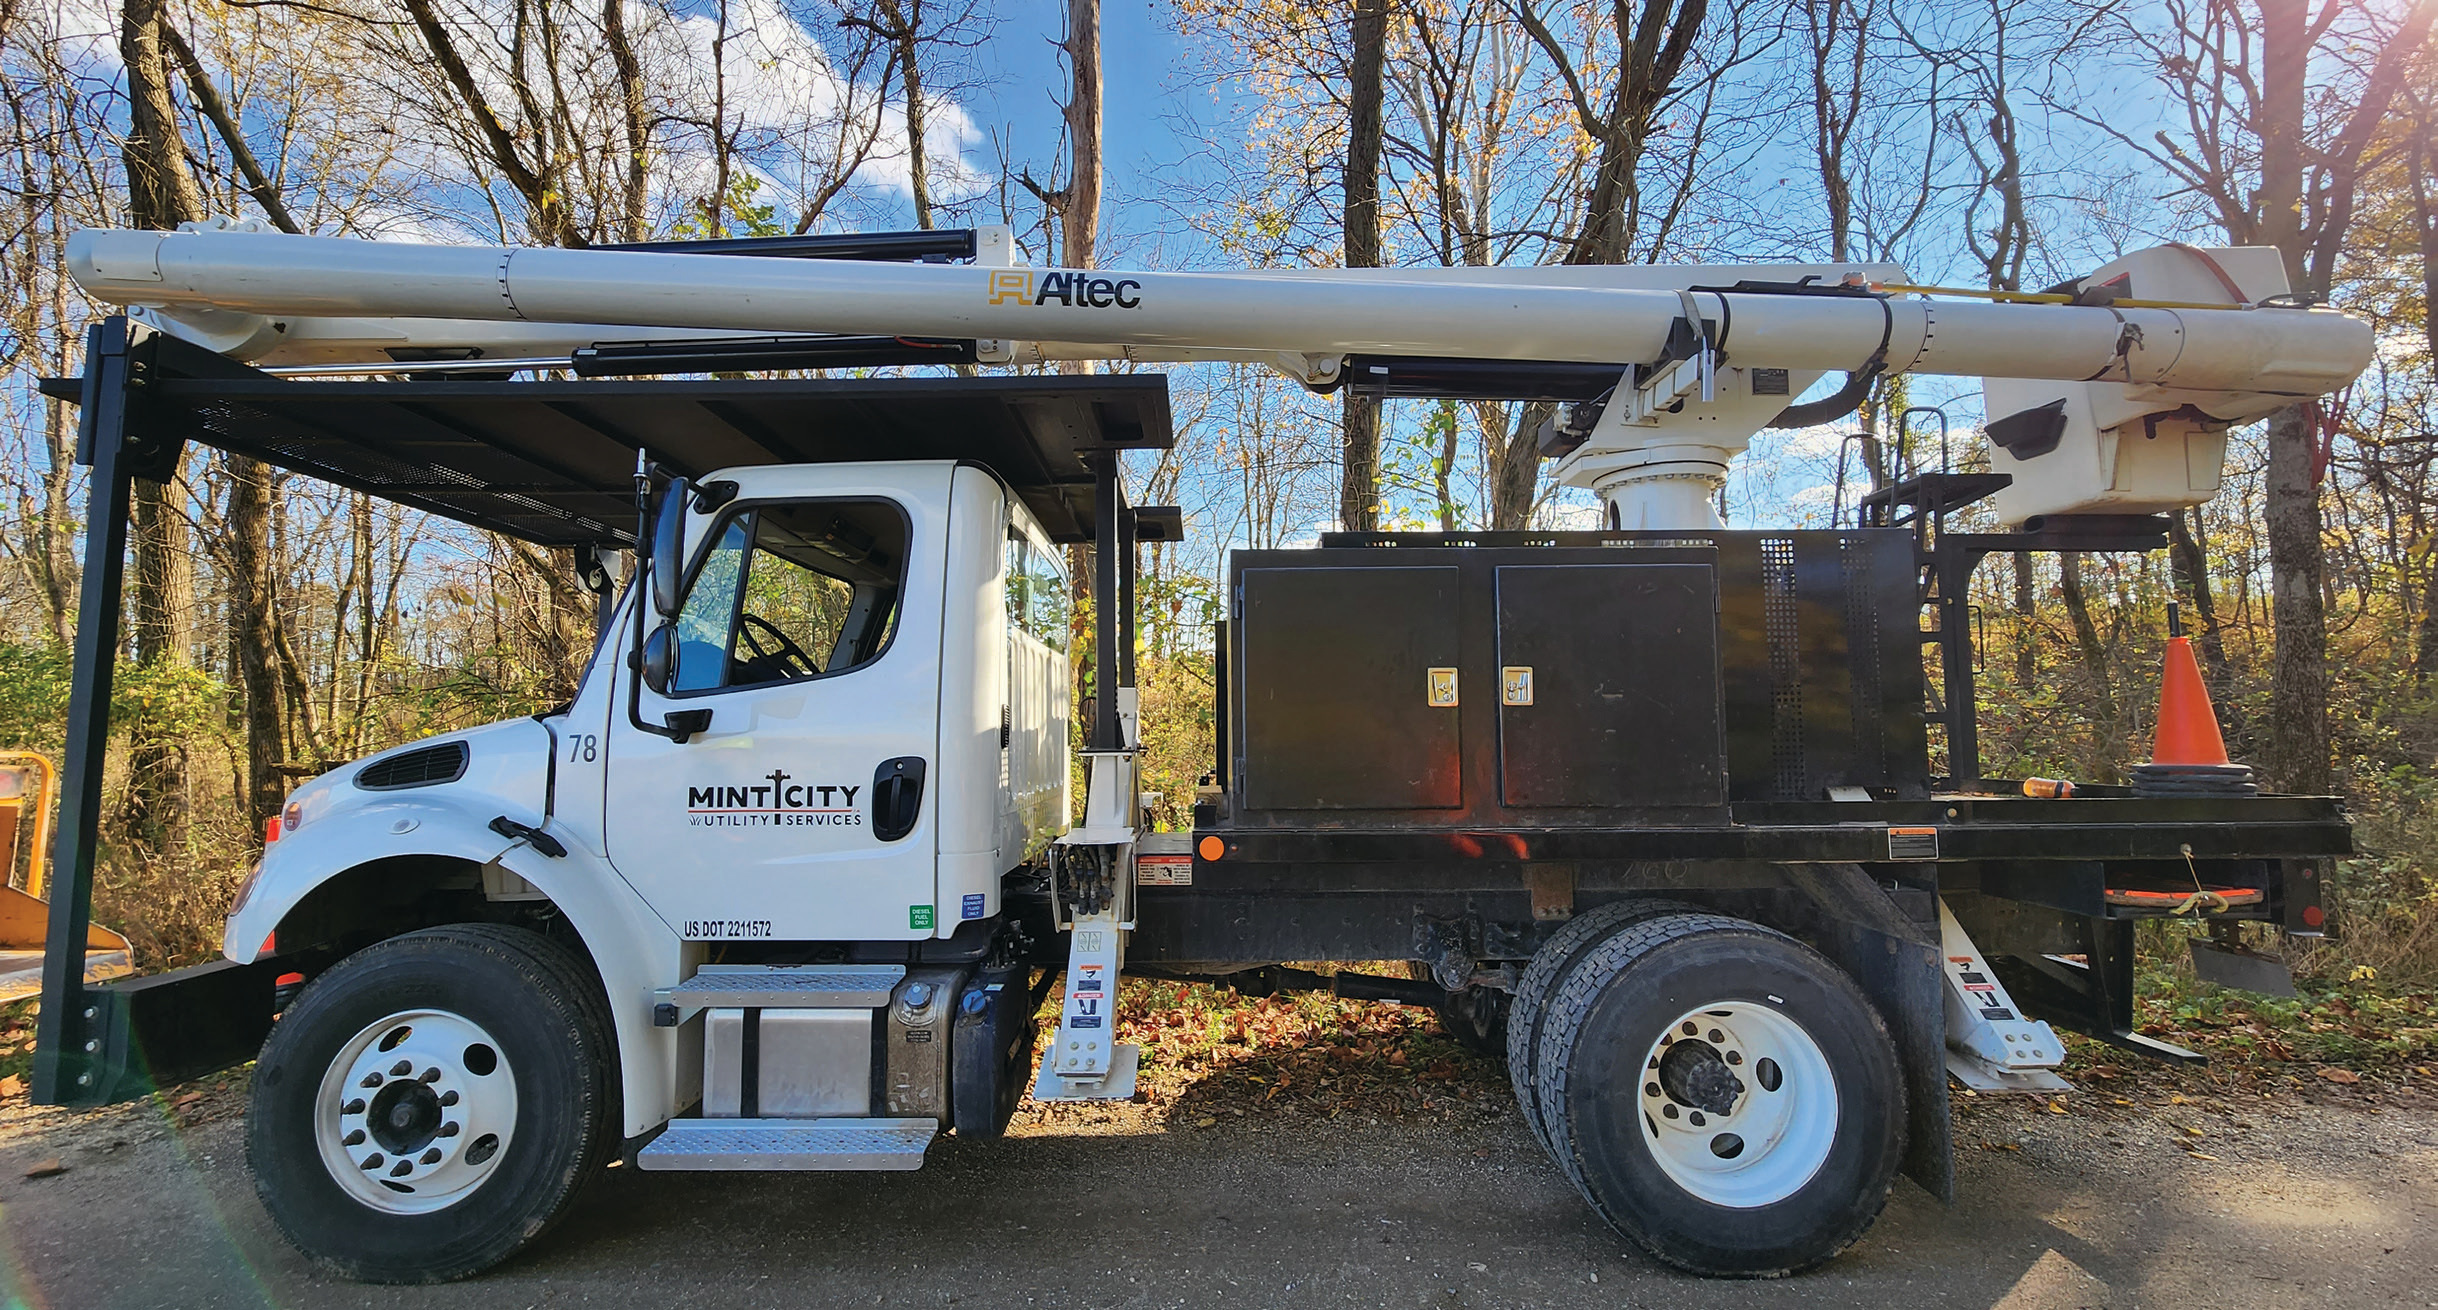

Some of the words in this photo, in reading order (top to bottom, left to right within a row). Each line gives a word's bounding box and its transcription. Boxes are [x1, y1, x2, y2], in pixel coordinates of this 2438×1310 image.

[1035, 271, 1141, 309] Altec
[569, 734, 597, 763] 78
[688, 786, 771, 808] MINT
[784, 785, 861, 808] CITY
[704, 815, 769, 827] UTILITY
[786, 814, 862, 826] SERVICES
[684, 920, 699, 937] US
[702, 920, 725, 937] DOT
[727, 920, 772, 937] 2211572
